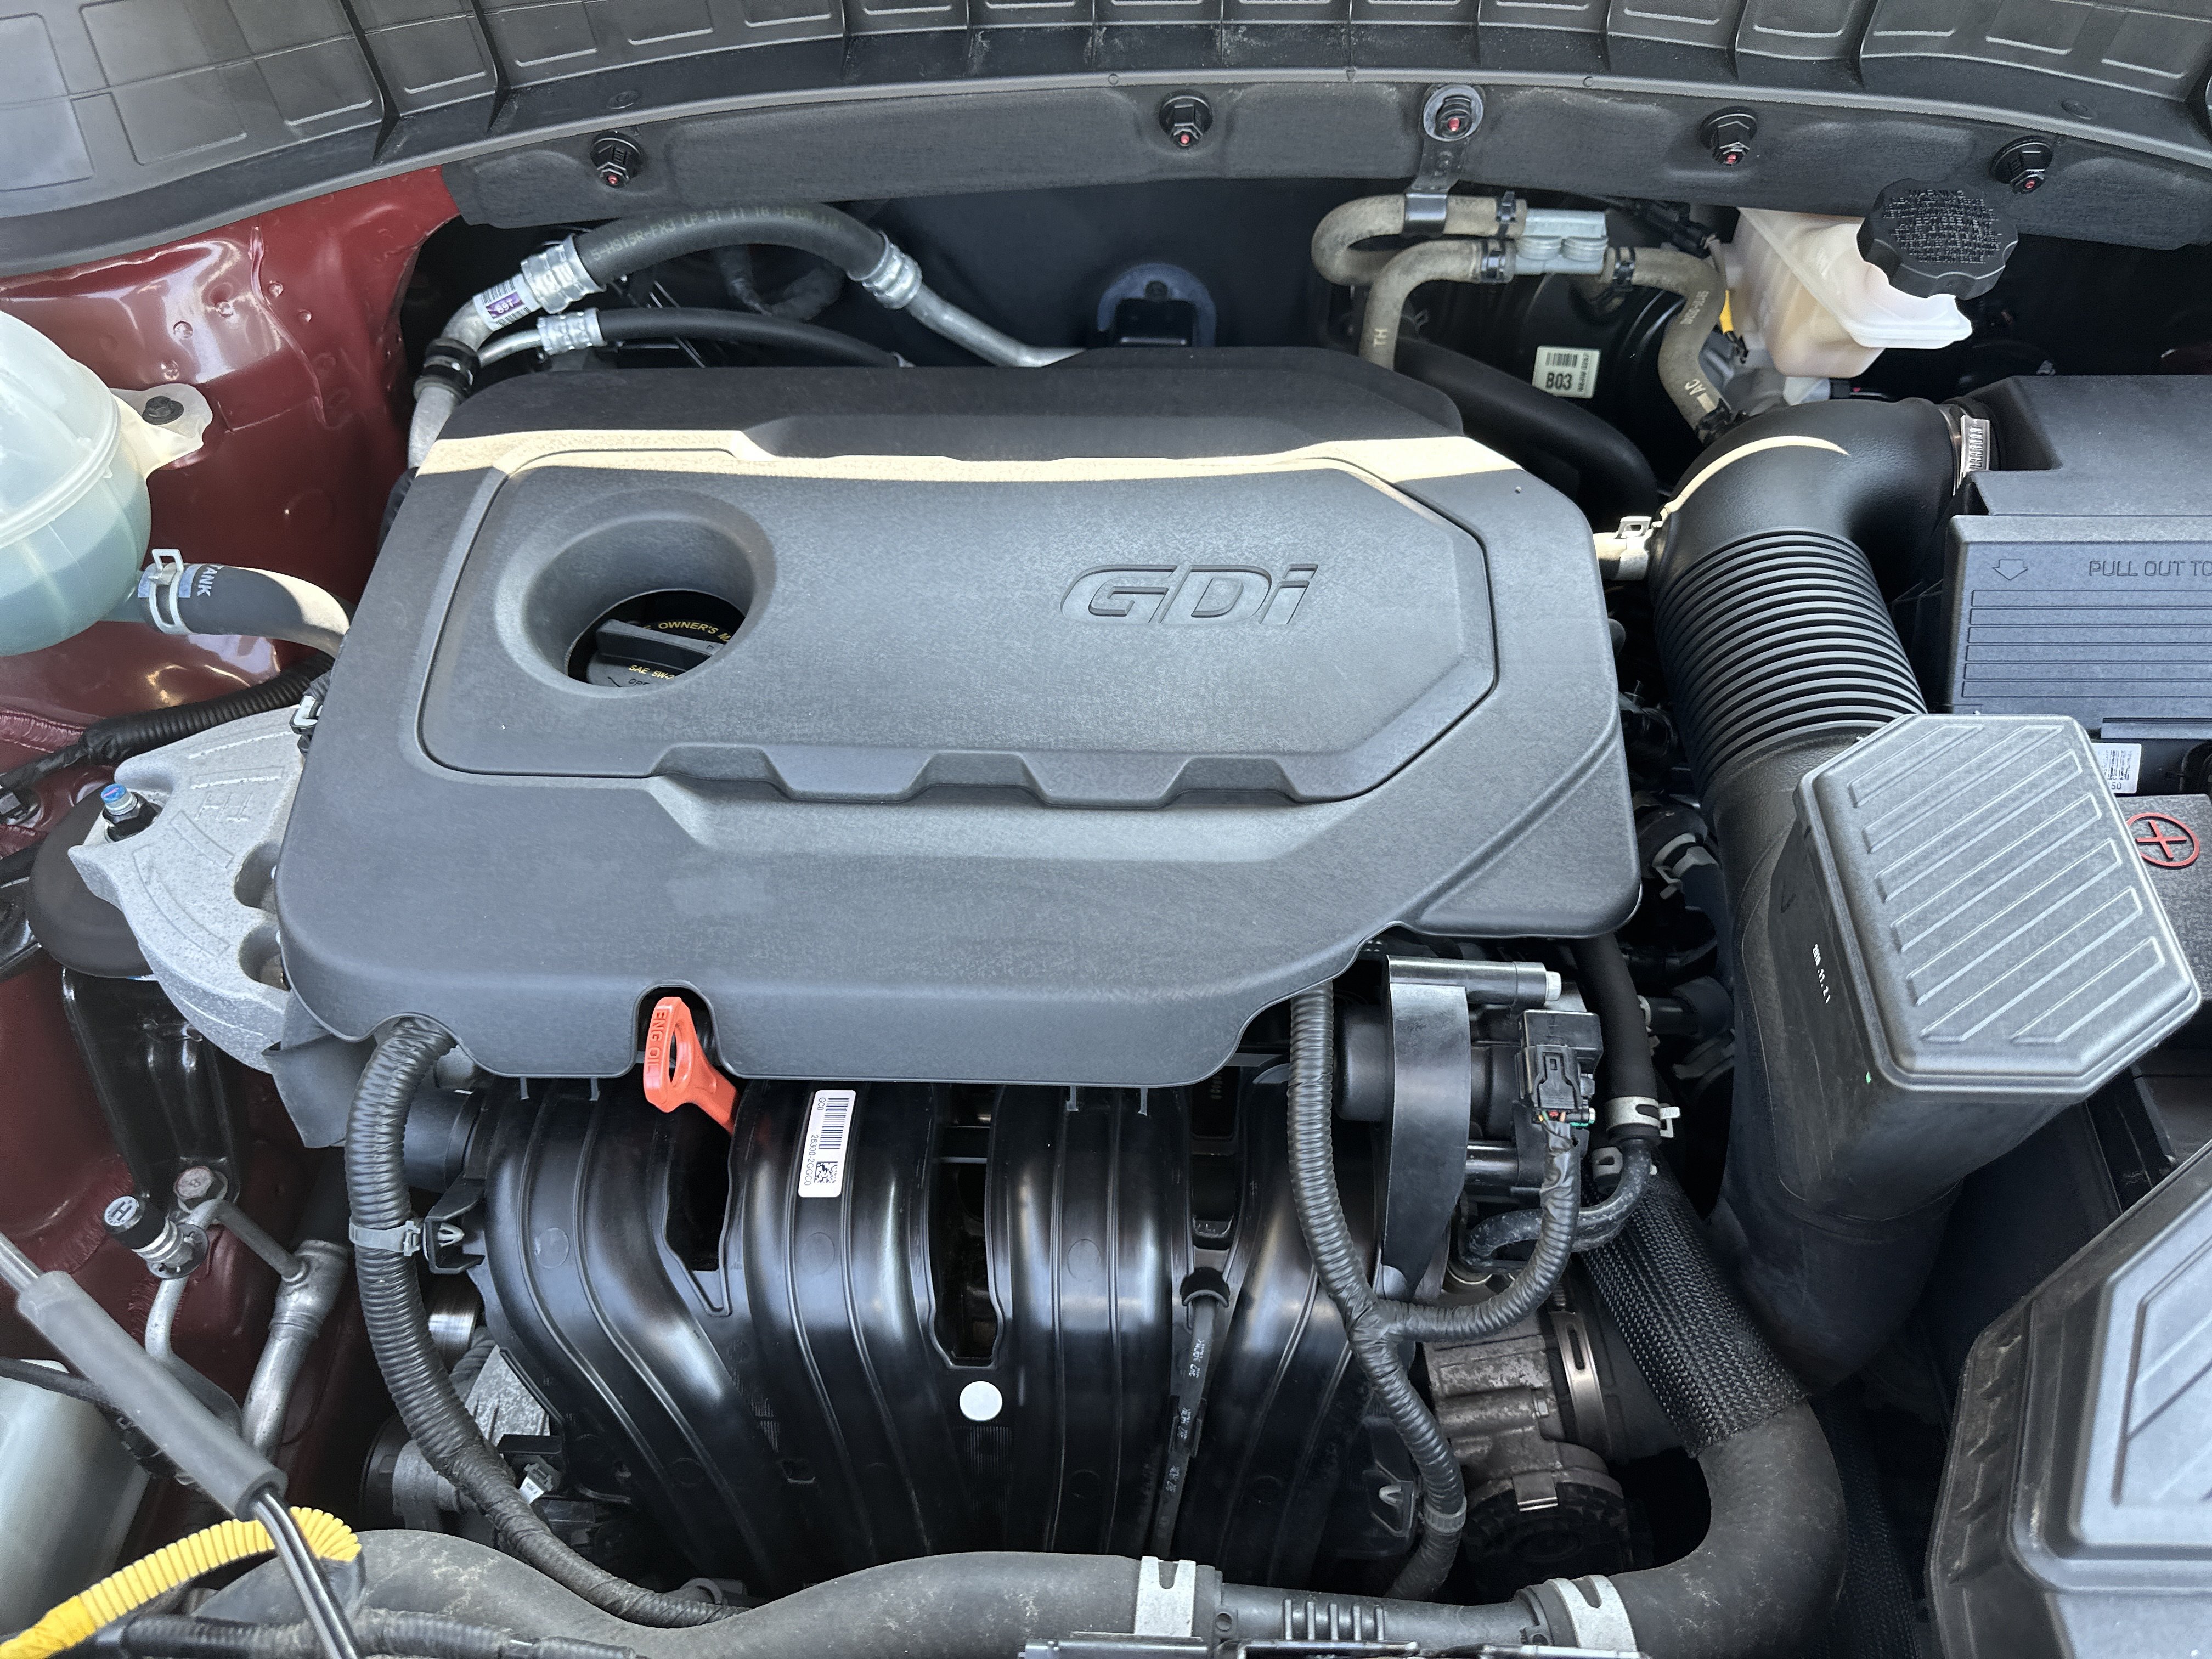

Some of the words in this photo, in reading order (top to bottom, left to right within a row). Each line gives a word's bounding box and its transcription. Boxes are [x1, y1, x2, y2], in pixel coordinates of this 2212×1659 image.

[2089, 560, 2138, 577] PULL
[2144, 560, 2186, 577] OUT
[1060, 564, 1318, 625] GDi
[658, 621, 719, 634] OWNER'S
[628, 664, 650, 674] SAE
[649, 1010, 667, 1042] ENG
[646, 1046, 662, 1074] OIL
[110, 1201, 133, 1221] H
